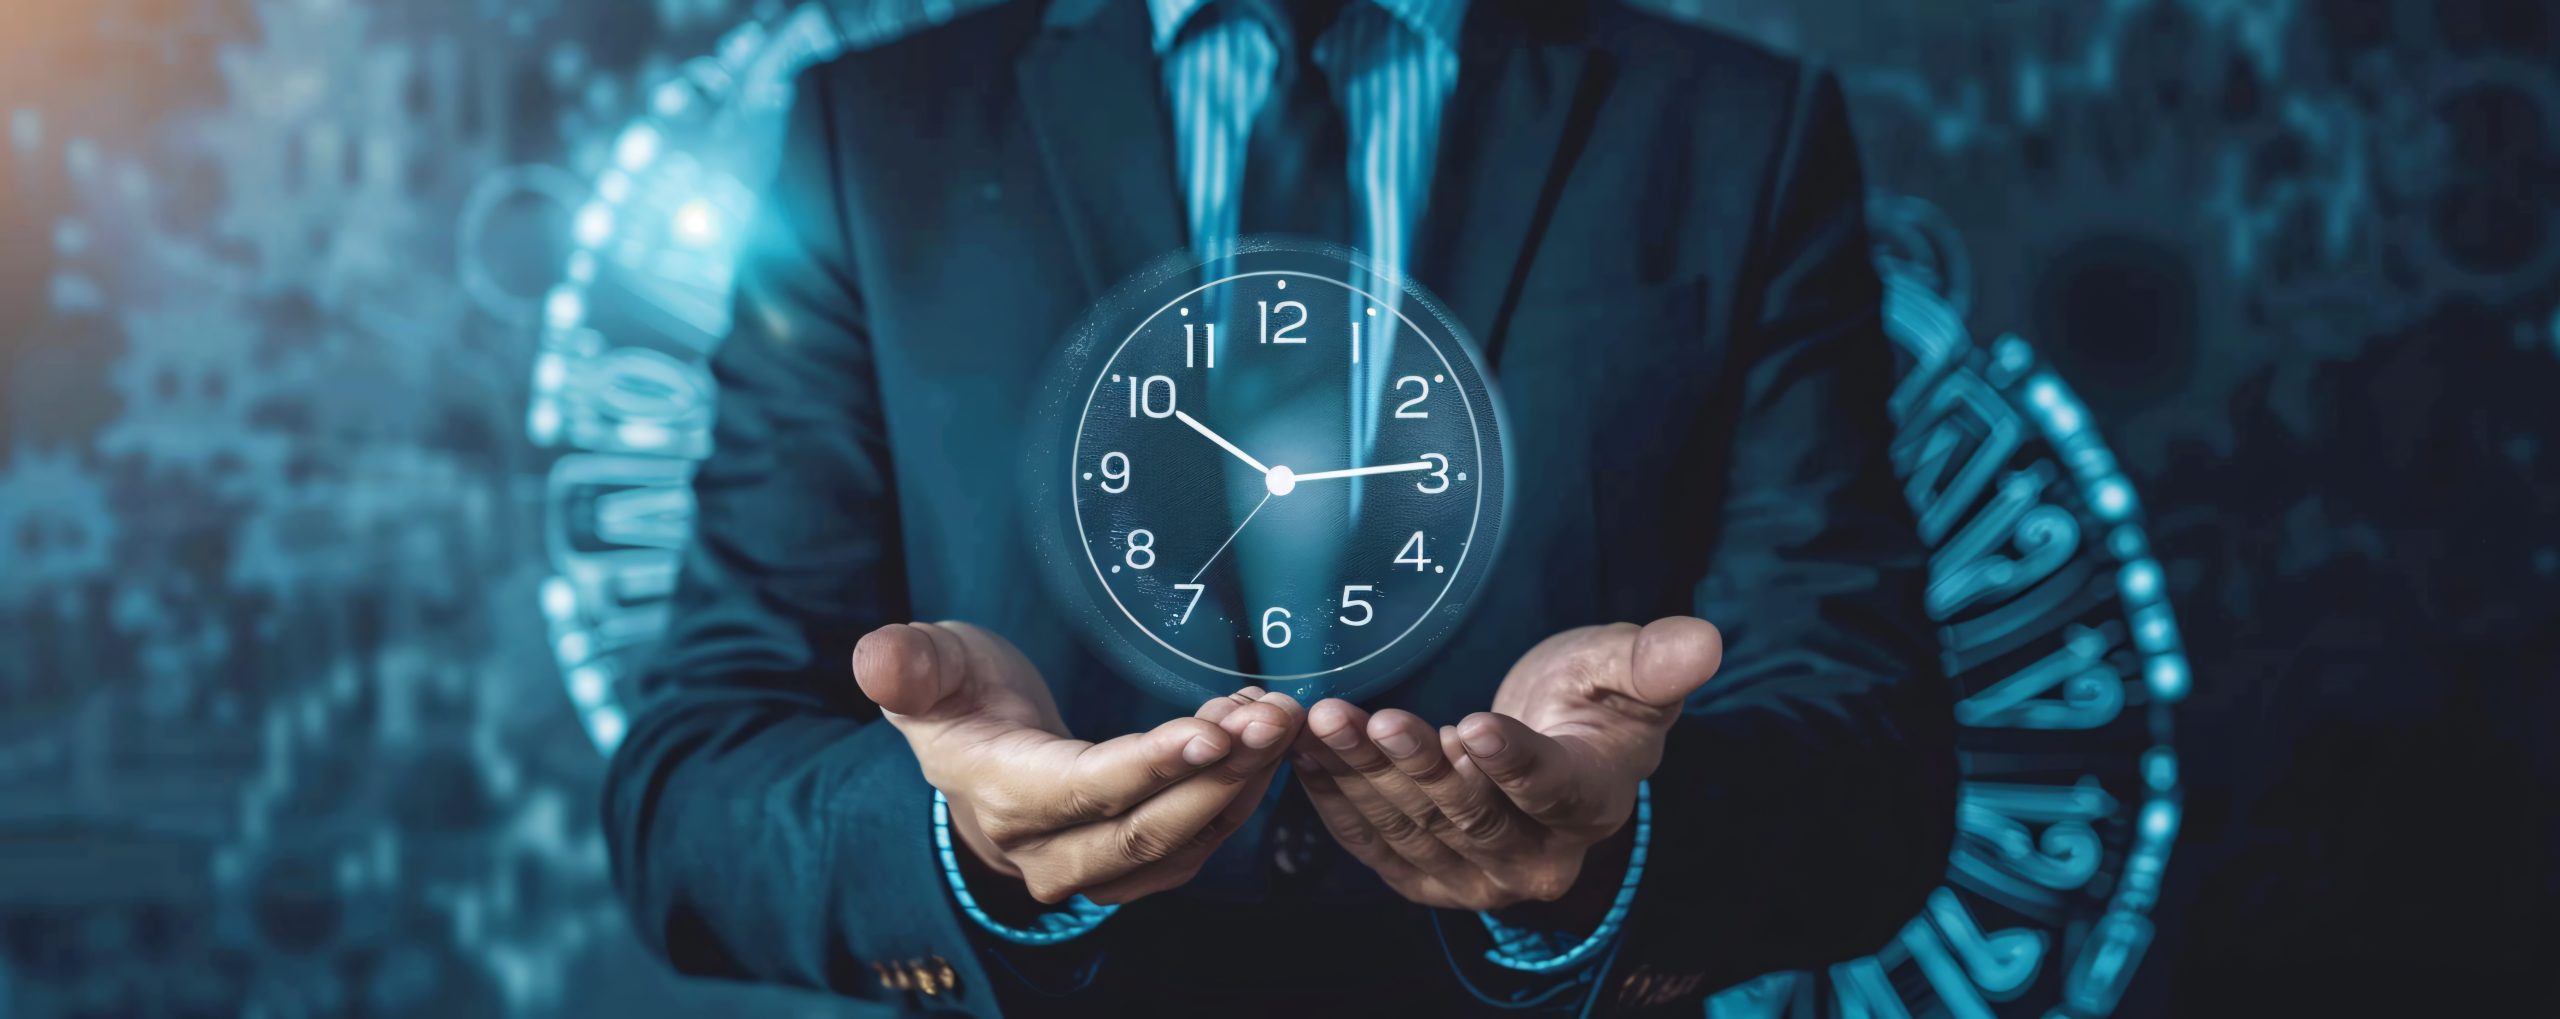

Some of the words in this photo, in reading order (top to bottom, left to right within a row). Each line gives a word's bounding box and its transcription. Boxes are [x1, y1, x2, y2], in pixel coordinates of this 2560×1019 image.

[1257, 300, 1308, 344] 12
[1184, 323, 1215, 368] 11
[1128, 374, 1177, 419] 10
[1395, 375, 1429, 419] 2
[1100, 451, 1131, 494] 9
[1416, 452, 1449, 494] 3
[1125, 528, 1156, 570] 8
[1393, 530, 1432, 572] 4
[1173, 583, 1205, 625] 7
[1339, 584, 1374, 626] 5
[1261, 606, 1292, 649] 6
